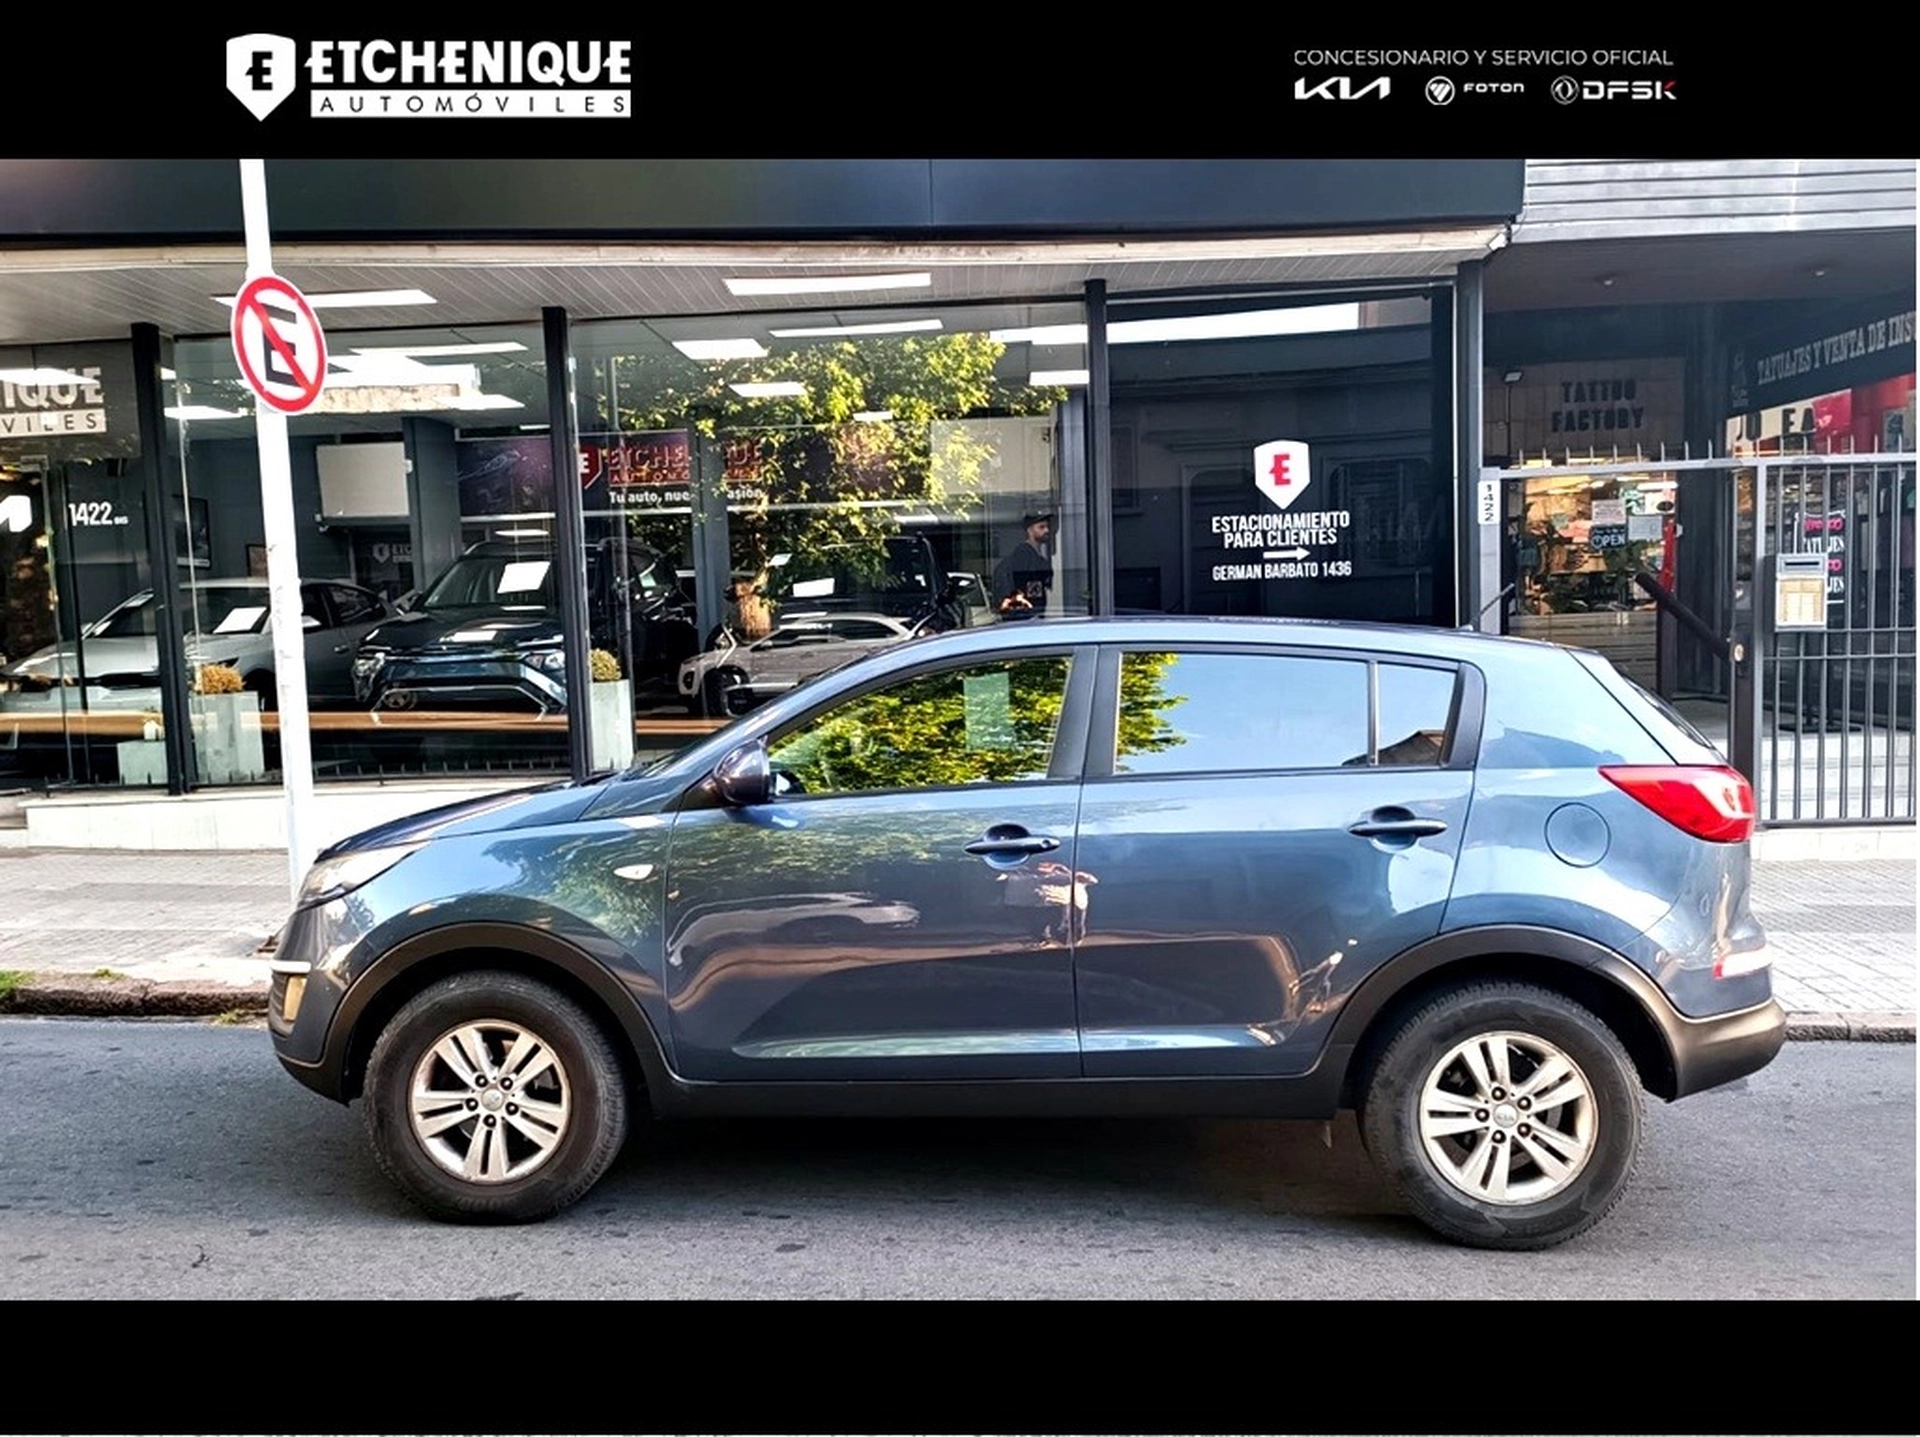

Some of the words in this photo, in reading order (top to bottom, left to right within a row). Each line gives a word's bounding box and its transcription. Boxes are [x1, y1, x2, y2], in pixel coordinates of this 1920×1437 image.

[1757, 345, 1811, 385] TATUAJES
[1812, 341, 1823, 369] Y
[1823, 327, 1865, 365] VENTA
[1867, 319, 1887, 354] DE
[1888, 310, 1917, 347] INS
[1561, 380, 1637, 403] TATTOO
[1552, 407, 1645, 433] FACTORY
[609, 491, 626, 504] Tu
[664, 490, 691, 502] nue
[1484, 484, 1495, 522] 1422
[68, 501, 113, 527] 1422
[1212, 511, 1350, 533] ESTACIONAMIENTO
[1224, 530, 1264, 548] PARA
[1267, 528, 1338, 547] CLIENTES
[1212, 564, 1263, 581] GERMAN
[1264, 562, 1318, 579] BARBATO
[1322, 560, 1352, 577] 1436
